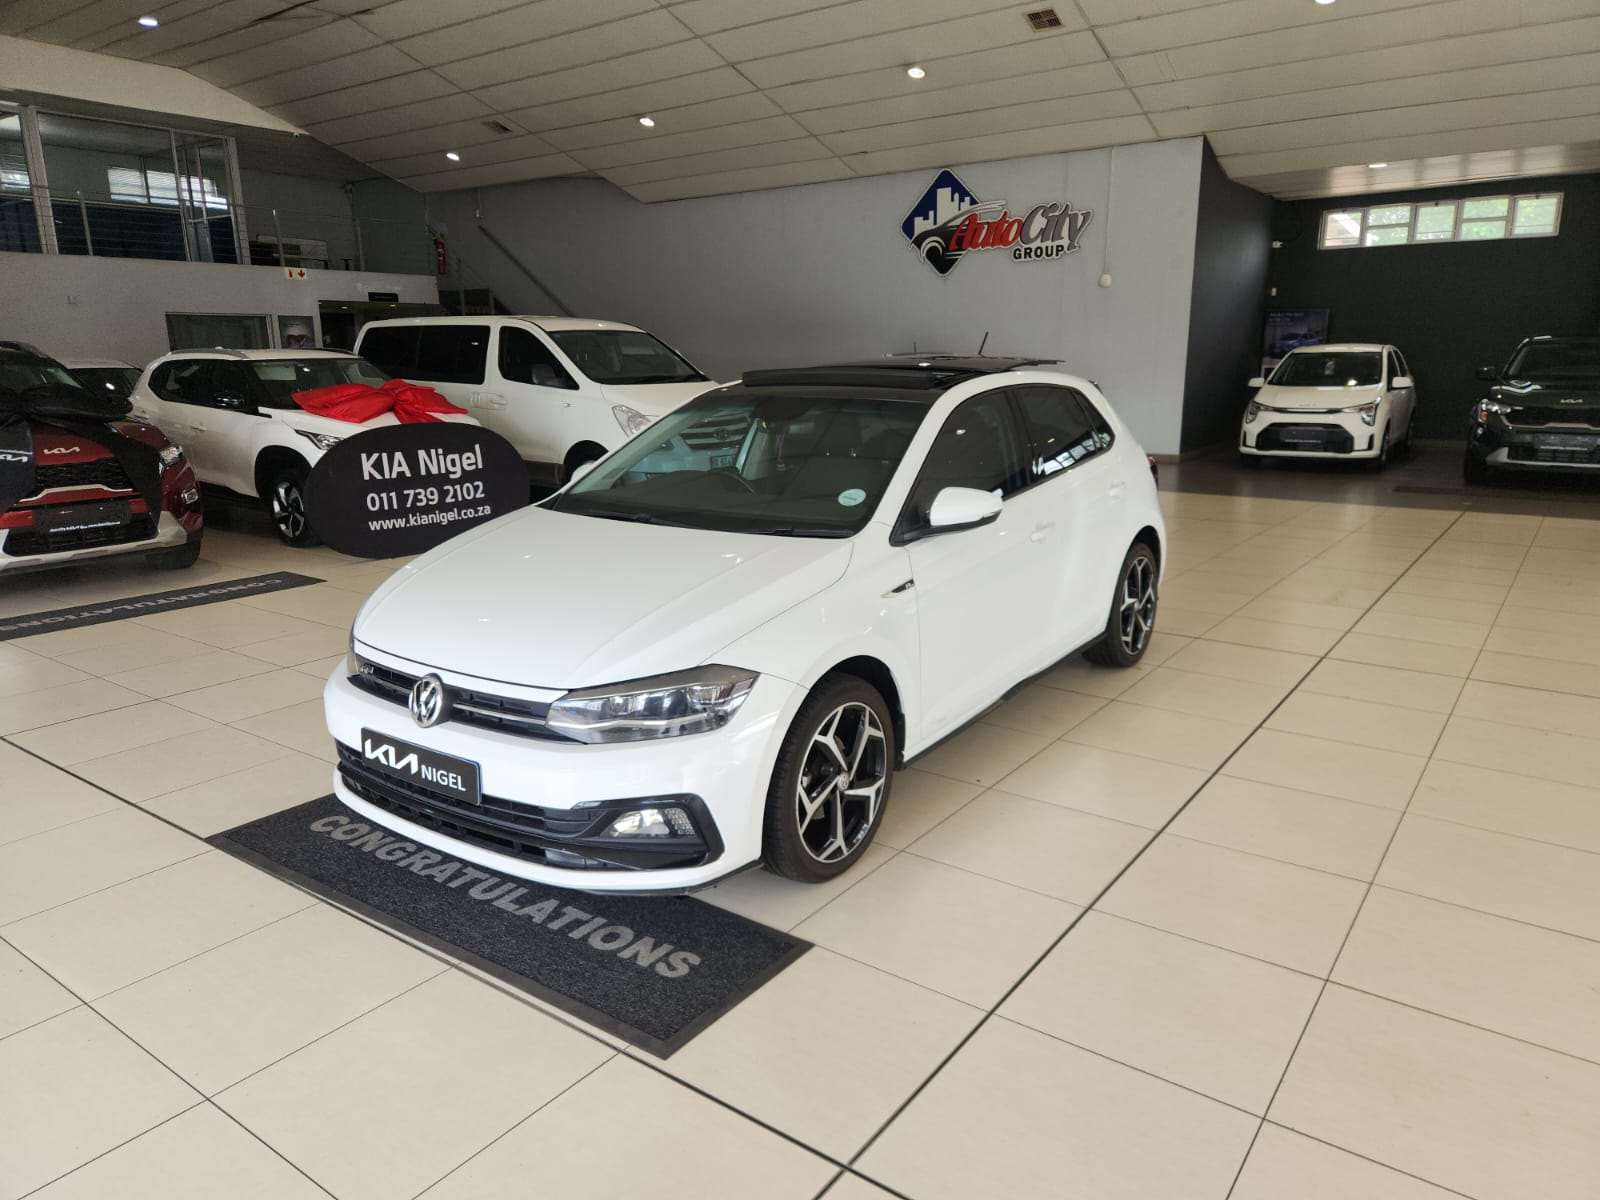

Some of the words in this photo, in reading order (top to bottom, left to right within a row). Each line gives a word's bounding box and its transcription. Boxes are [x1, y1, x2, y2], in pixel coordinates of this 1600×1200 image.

[1013, 244, 1064, 260] GROUP
[361, 451, 412, 480] KIA
[417, 443, 484, 479] Nigel
[366, 491, 398, 511] 011
[403, 487, 439, 508] 739
[443, 481, 485, 503] 2102
[368, 505, 491, 531] www.kianigel.co.za
[364, 738, 419, 775] KIA
[421, 764, 467, 792] NIGEL
[309, 814, 702, 979] CONGRATULATIONS
